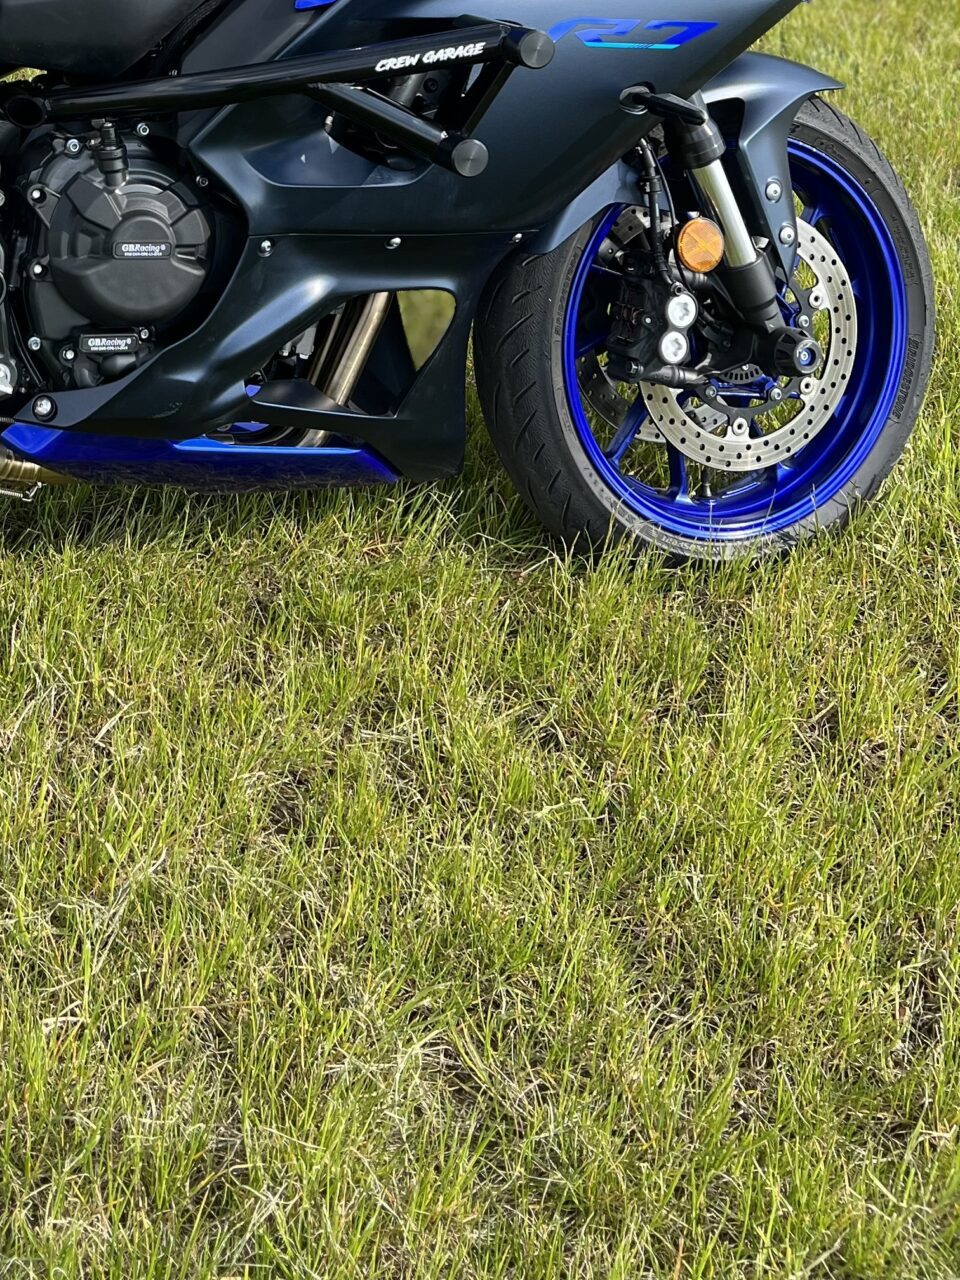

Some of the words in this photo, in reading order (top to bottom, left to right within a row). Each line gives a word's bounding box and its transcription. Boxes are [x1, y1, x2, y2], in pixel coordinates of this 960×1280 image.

[547, 16, 720, 47] R7
[375, 54, 420, 72] CREW
[422, 41, 486, 64] GARAGE
